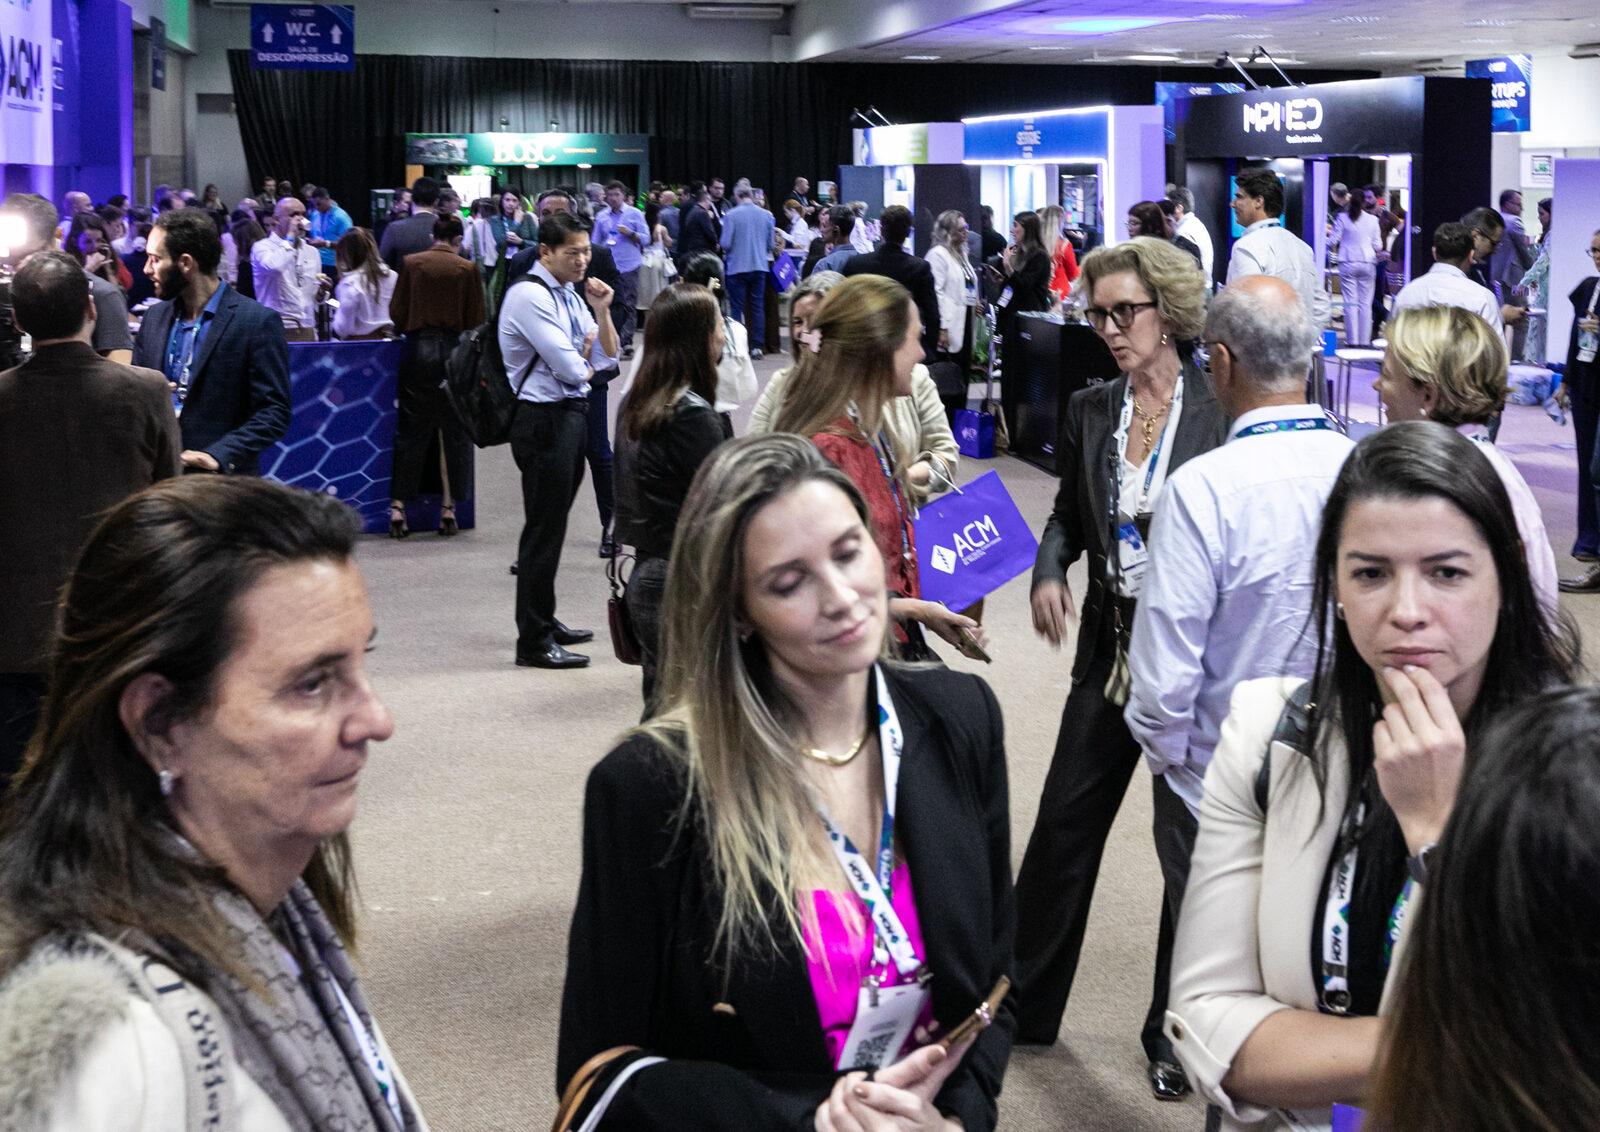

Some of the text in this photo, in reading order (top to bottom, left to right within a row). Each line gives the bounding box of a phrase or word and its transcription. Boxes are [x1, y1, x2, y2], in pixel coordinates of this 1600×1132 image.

[285, 22, 321, 36] W.C.
[257, 52, 349, 63] DESCOMPRESSÃO
[953, 514, 1000, 558] ACM
[848, 861, 865, 882] ACM
[878, 912, 895, 934] ACM
[1332, 934, 1342, 962] ACM
